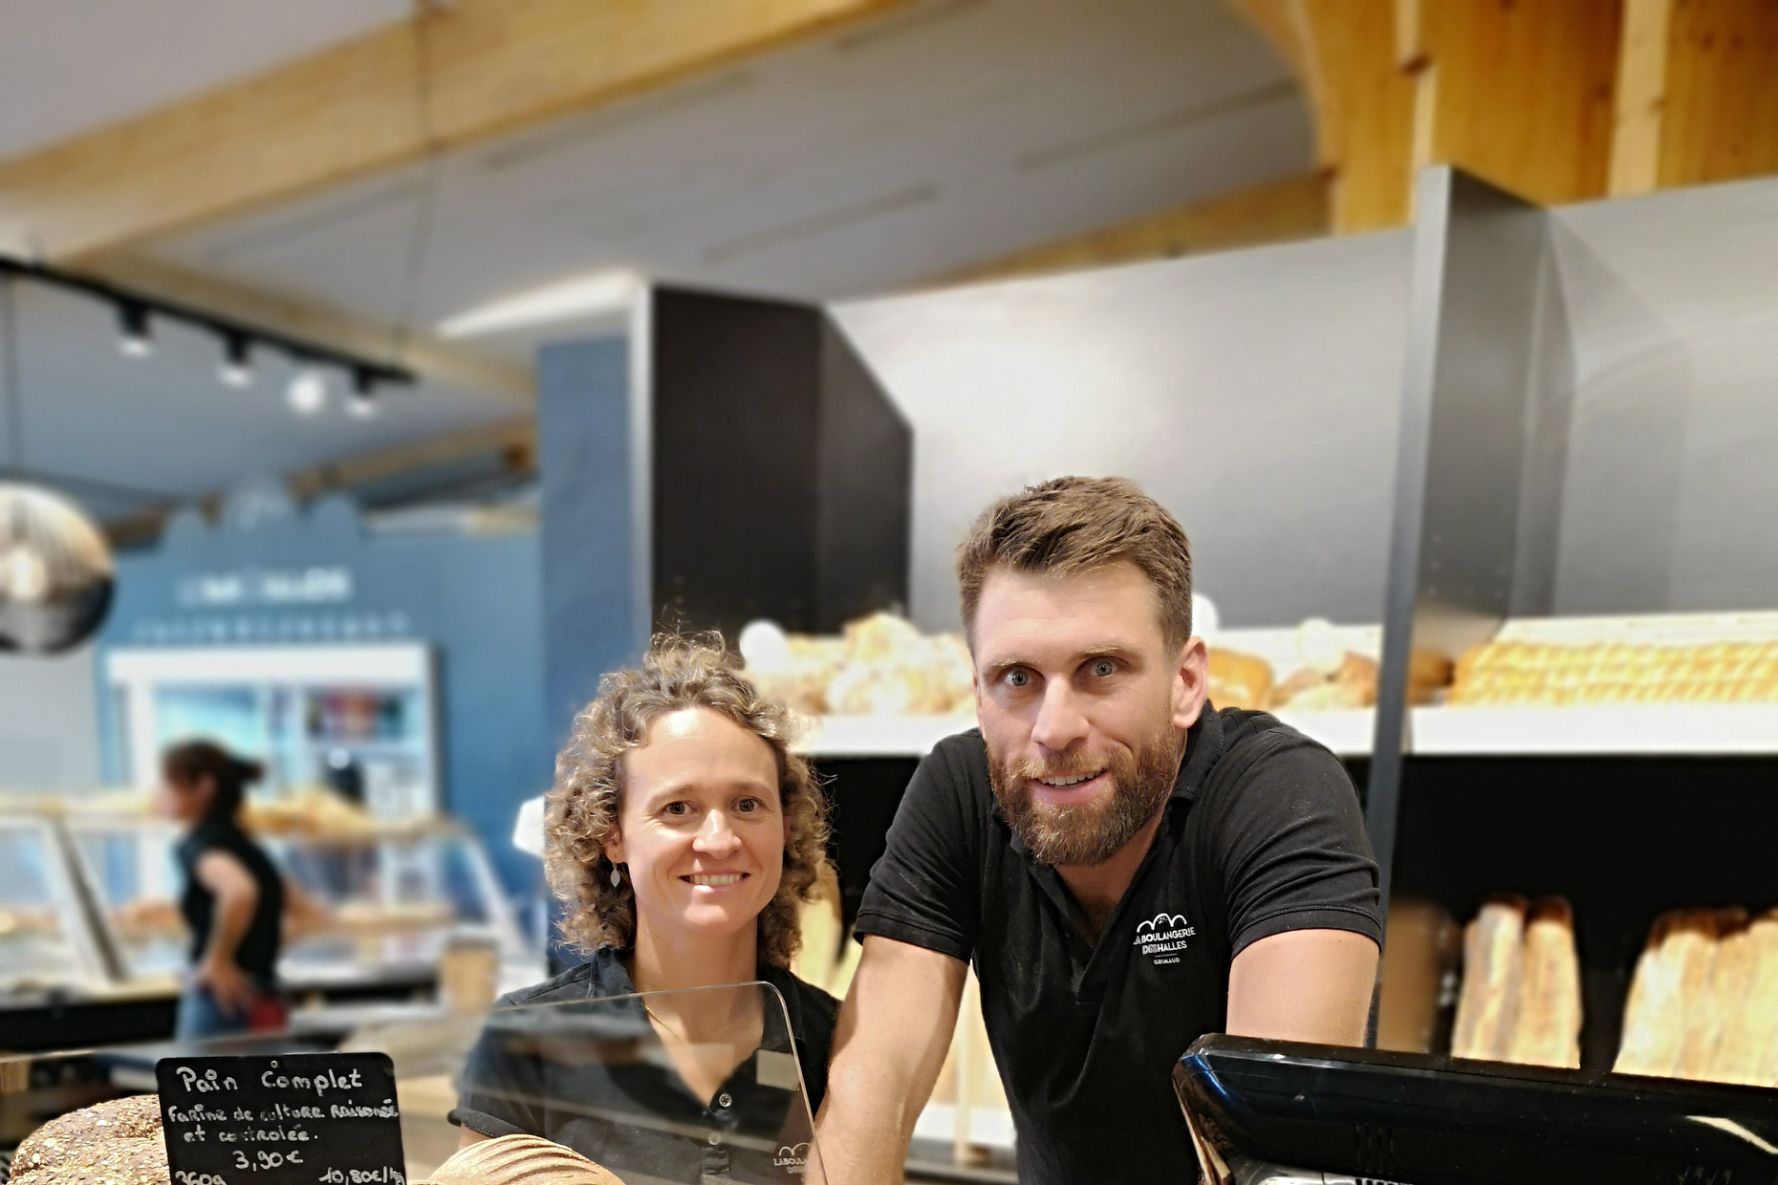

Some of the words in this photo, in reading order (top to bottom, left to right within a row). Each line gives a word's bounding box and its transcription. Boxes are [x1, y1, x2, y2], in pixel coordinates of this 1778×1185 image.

[1140, 927, 1196, 943] BOULANGERIE
[1157, 940, 1187, 953] HALLES
[176, 1066, 238, 1092] Pain
[261, 1068, 362, 1096] Complet
[233, 1106, 254, 1121] de
[184, 1124, 206, 1143] et
